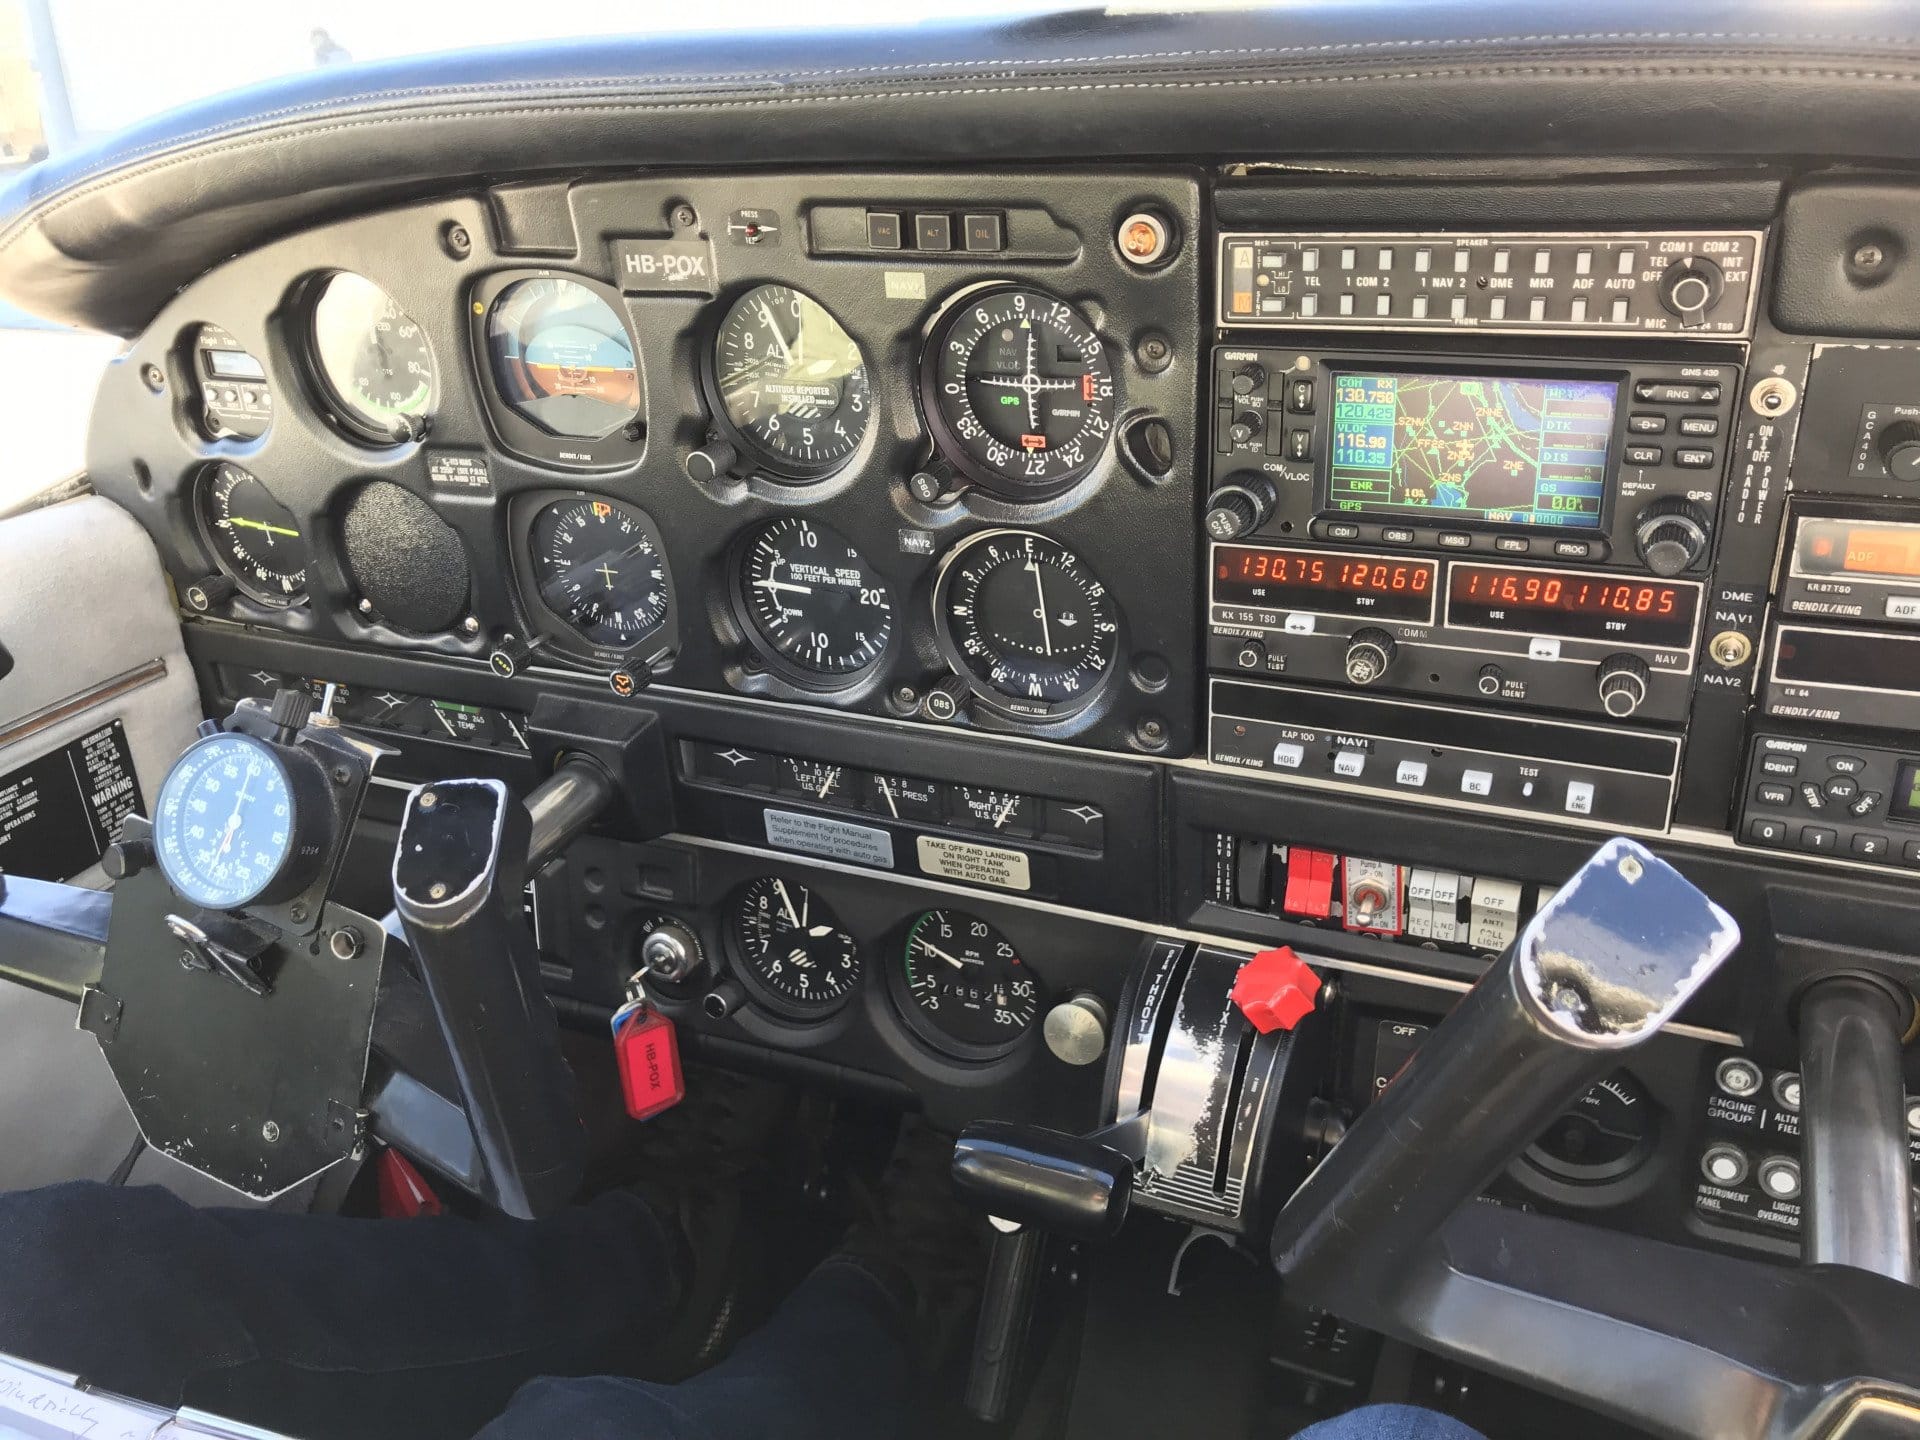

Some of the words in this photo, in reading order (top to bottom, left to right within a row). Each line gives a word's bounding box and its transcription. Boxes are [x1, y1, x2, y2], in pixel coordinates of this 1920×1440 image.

[976, 229, 989, 239] OIL
[625, 254, 706, 276] HB-POX
[1650, 257, 1668, 267] TEL
[1723, 257, 1743, 267] INT
[1305, 276, 1321, 286] TEL
[1643, 271, 1663, 282] OFF
[1726, 272, 1748, 282] EXT
[1490, 278, 1513, 288] DME
[1530, 278, 1554, 288] MKR
[1572, 279, 1594, 289] ADF
[1605, 279, 1636, 289] AUTO
[1051, 302, 1071, 323] 12
[1454, 317, 1478, 326] PHONE
[1645, 319, 1667, 329] MIC
[1224, 352, 1258, 361] GARMIN
[1681, 368, 1701, 376] GNS
[1339, 378, 1363, 388] COM
[1377, 379, 1393, 388] RX
[1336, 389, 1394, 403] 130.750
[1666, 389, 1689, 399] RNG
[1000, 396, 1020, 405] GPS
[1052, 408, 1080, 417] GARMIN
[1336, 404, 1394, 418] 120.425
[1338, 424, 1368, 433] VLOC
[1547, 420, 1571, 431] DTK
[1684, 423, 1714, 433] MENU
[1760, 425, 1774, 436] ON
[1337, 434, 1387, 449] 116.90
[1337, 450, 1386, 464] 110.35
[1543, 451, 1568, 462] DIS
[1634, 452, 1653, 461] CLR
[1684, 455, 1705, 464] ENT
[1752, 450, 1771, 462] OFF
[1350, 481, 1373, 491] ENR
[1540, 483, 1557, 492] GS
[1623, 482, 1656, 490] DEFAULT
[1687, 490, 1713, 500] GPS
[1340, 502, 1362, 511] GPS
[1488, 512, 1513, 521] NAV
[1217, 512, 1234, 535] PUSH
[1334, 527, 1350, 536] CDI
[1388, 531, 1407, 541] OBS
[800, 531, 817, 547] 10
[904, 538, 930, 548] NAV2
[1444, 535, 1465, 545] MSG
[1504, 540, 1522, 550] FPL
[1559, 545, 1585, 555] PROC
[790, 564, 829, 576] VERTICAL
[835, 568, 860, 578] SPEED
[1242, 556, 1324, 582] 130.75
[1340, 563, 1428, 590] 120.60
[860, 588, 881, 605] 20
[1253, 588, 1266, 596] USE
[1470, 575, 1562, 602] 116.90
[1578, 585, 1675, 613] 110.85
[1722, 590, 1754, 602] DME
[1356, 597, 1375, 606] STBY
[783, 608, 803, 616] DOWN
[1792, 601, 1862, 616] BENDIX/KING
[1894, 605, 1916, 615] ADF
[1489, 610, 1505, 619] USE
[1715, 611, 1753, 624] NAV1
[1605, 622, 1627, 631] STBY
[1213, 626, 1264, 639] BENDIX/KING
[811, 632, 828, 648] 10
[1655, 654, 1678, 665] NAV
[1703, 673, 1742, 688] NAV2
[1502, 689, 1525, 699] IDENT
[934, 698, 949, 709] OBS
[1772, 705, 1840, 720] BENDIX/KING
[1282, 730, 1298, 739] KAP
[1301, 732, 1315, 741] 100
[1337, 735, 1369, 748] NAV1
[1765, 739, 1807, 752] GARMIN
[1215, 753, 1264, 767] BENDIX/KING
[1338, 763, 1355, 772] NAV
[1519, 766, 1539, 777] TEST
[1764, 762, 1795, 773] IDENT
[1836, 761, 1854, 771] ON
[1401, 773, 1419, 782] APR
[91, 776, 133, 808] WARNING
[878, 787, 899, 797] FEL
[903, 790, 928, 802] PRESS
[1764, 791, 1785, 801] VFR
[1830, 785, 1851, 796] ALT
[1803, 787, 1821, 808] STBY
[1855, 796, 1873, 813] OFF
[770, 815, 792, 825] Refer
[794, 819, 802, 827] to
[803, 821, 816, 830] the
[818, 823, 840, 835] Flight
[842, 827, 872, 840] Manual
[1763, 826, 1773, 838] 0
[772, 824, 819, 840] Supplement
[821, 832, 832, 841] for
[833, 836, 878, 851] procedures
[774, 835, 794, 844] when
[796, 840, 834, 854] operating
[835, 847, 852, 856] with
[853, 851, 871, 860] auto
[926, 840, 946, 850] TAKE
[948, 844, 964, 852] OFF
[966, 847, 983, 856] AND
[985, 850, 1021, 863] LANDING
[1864, 841, 1875, 853] 2
[943, 851, 954, 859] ON
[957, 853, 981, 863] RIGHT
[983, 858, 1005, 868] TANK
[939, 858, 962, 868] WHEN
[964, 861, 1010, 877] OPERATING
[943, 867, 963, 877] WITH
[965, 871, 987, 881] AUTO
[1411, 886, 1432, 897] OFF
[1434, 890, 1455, 900] OFF
[1483, 896, 1504, 906] OFF
[1434, 922, 1454, 931] LND
[1483, 918, 1504, 927] ANTI
[941, 924, 953, 938] 15
[970, 921, 988, 937] 20
[1477, 937, 1504, 948] LIGHT
[996, 942, 1014, 958] 25
[1011, 981, 1030, 997] 30
[994, 1009, 1012, 1025] 35
[1392, 1025, 1417, 1037] OFF
[645, 1042, 662, 1091] HB-POX
[1709, 1096, 1757, 1115] ENGINE
[1707, 1107, 1752, 1124] GROUP
[1698, 1184, 1750, 1203] INSTRUMENT
[1696, 1195, 1721, 1209] PANEL
[1772, 1200, 1800, 1214] LIGHTS
[1757, 1209, 1799, 1226] OVERHEAD
